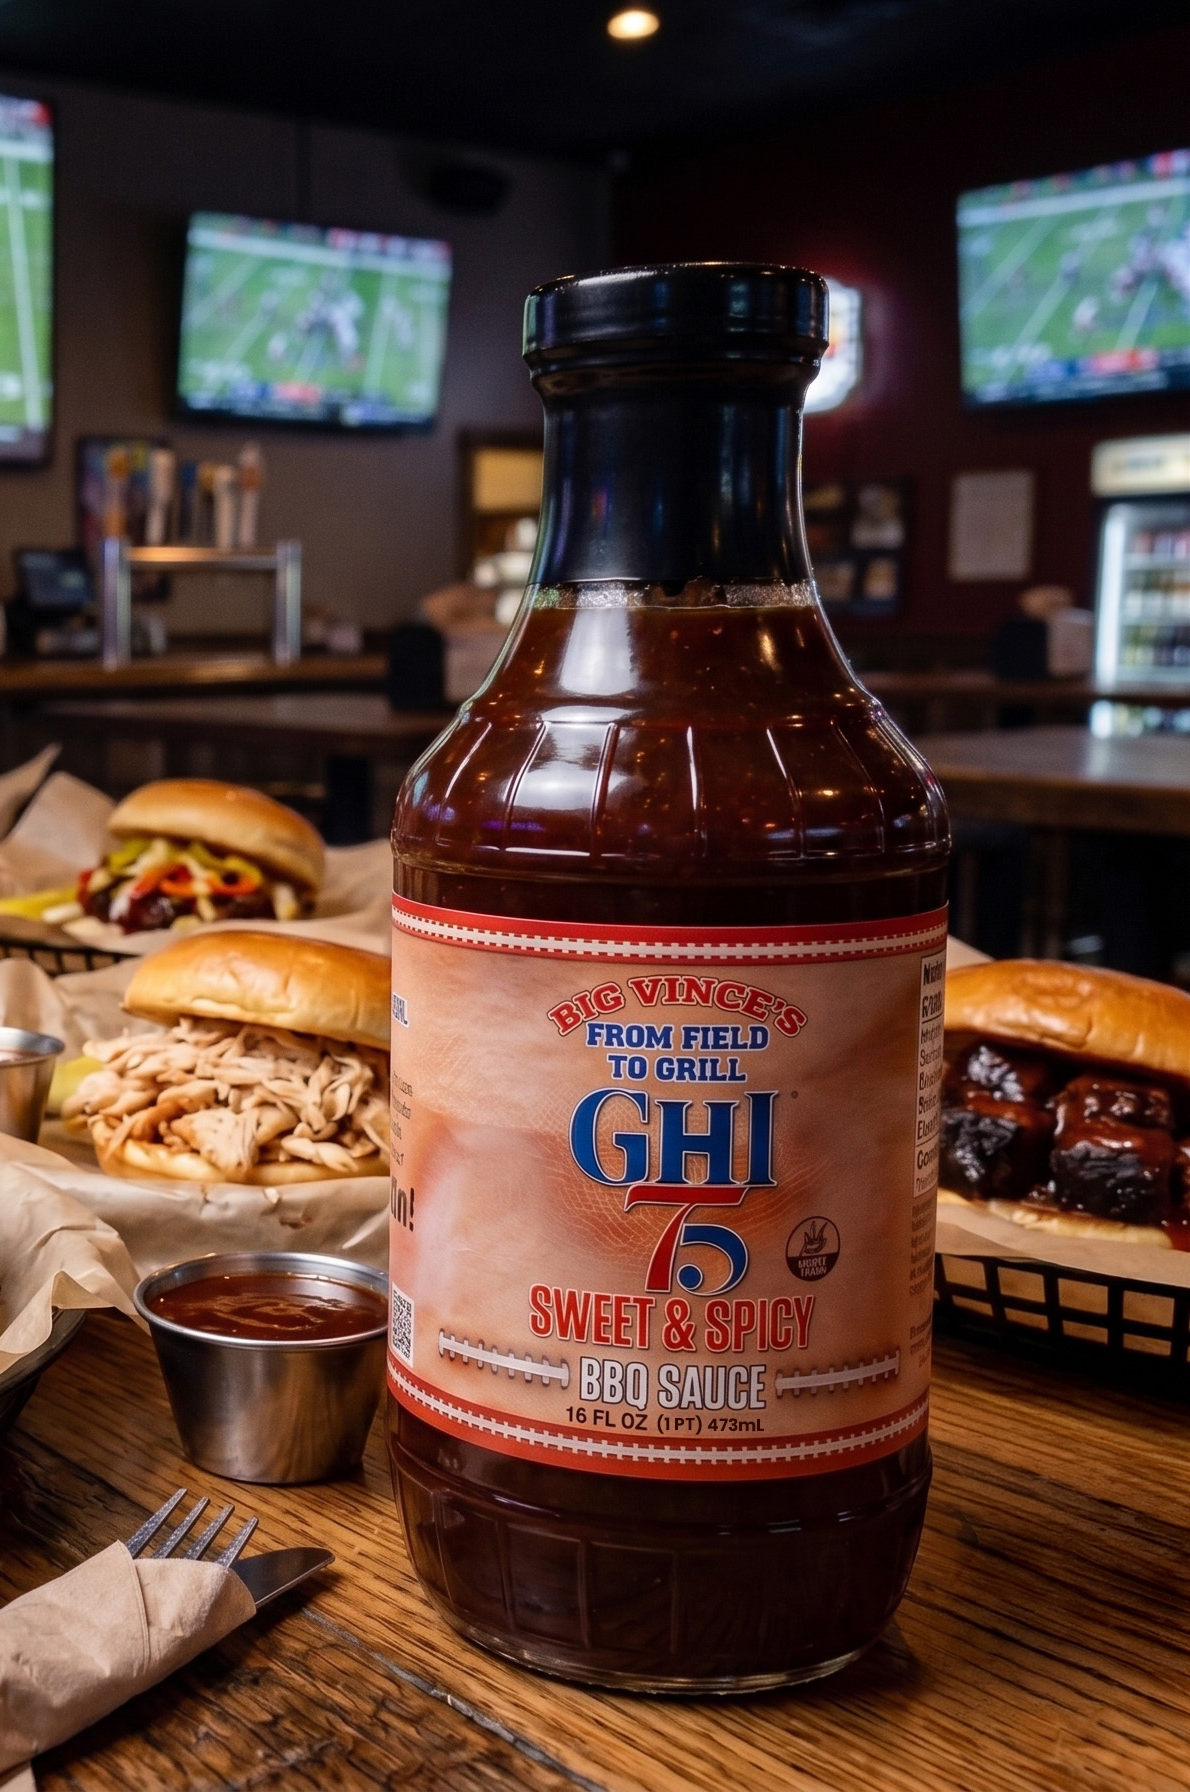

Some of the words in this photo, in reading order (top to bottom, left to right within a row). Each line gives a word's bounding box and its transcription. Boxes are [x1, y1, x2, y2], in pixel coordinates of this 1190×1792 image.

[548, 982, 625, 1036] BIG
[628, 975, 808, 1037] VINCE'S
[586, 1022, 674, 1050] FROM
[681, 1024, 770, 1051] FIELD
[607, 1054, 647, 1080] TO
[655, 1056, 747, 1083] GRILL
[569, 1087, 778, 1187] GHI
[624, 1185, 748, 1296] 75
[529, 1283, 655, 1349] SWEET
[662, 1297, 696, 1351] &
[705, 1295, 815, 1352] SPICY
[579, 1356, 649, 1410] BBQ
[657, 1363, 767, 1411] SAUCE
[566, 1406, 587, 1423] 16
[593, 1409, 616, 1427] FL
[621, 1412, 648, 1431] OZ
[707, 1418, 765, 1432] 473mL
